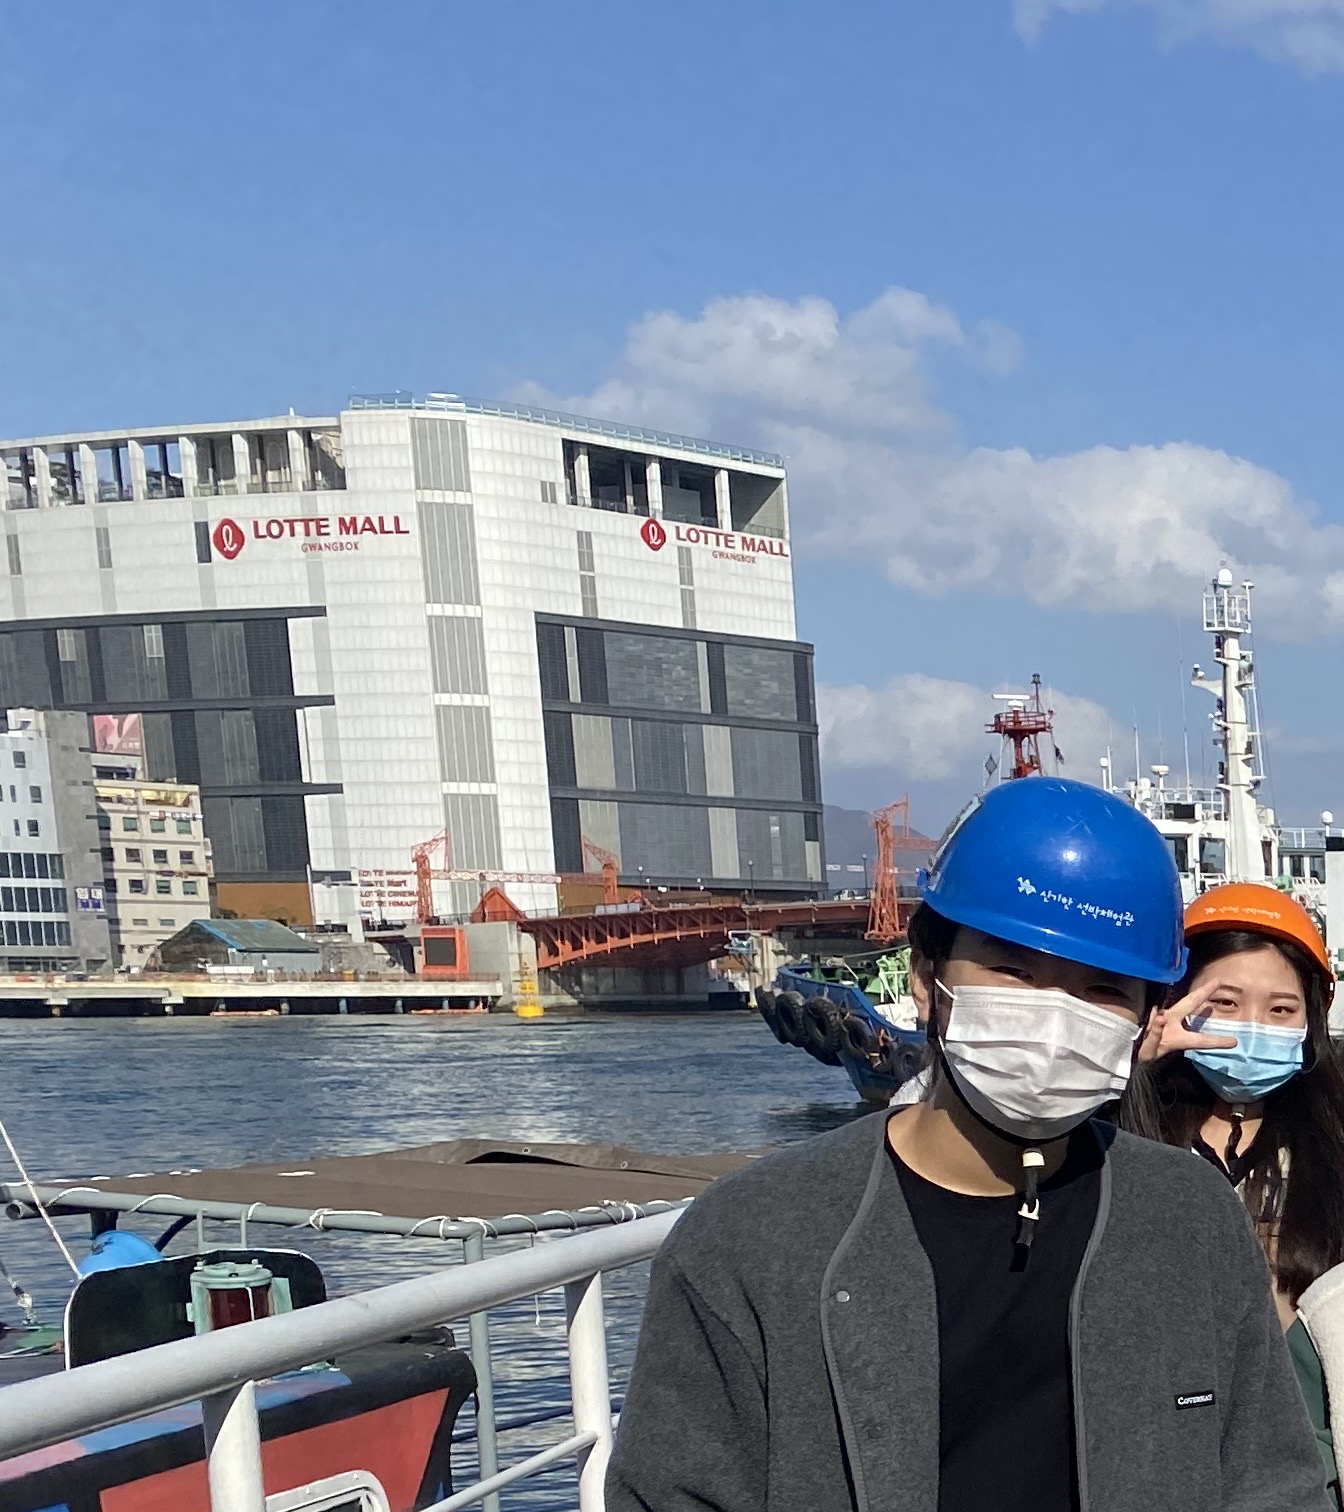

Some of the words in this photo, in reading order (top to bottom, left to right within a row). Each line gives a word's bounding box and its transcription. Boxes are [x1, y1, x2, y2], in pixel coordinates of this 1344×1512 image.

[253, 517, 331, 540] LOTTE
[338, 515, 410, 536] MALL
[301, 541, 360, 553] GWANGBOK
[675, 525, 736, 549] LOTTE
[741, 535, 789, 558] MALL
[711, 549, 756, 564] GWANGBOK
